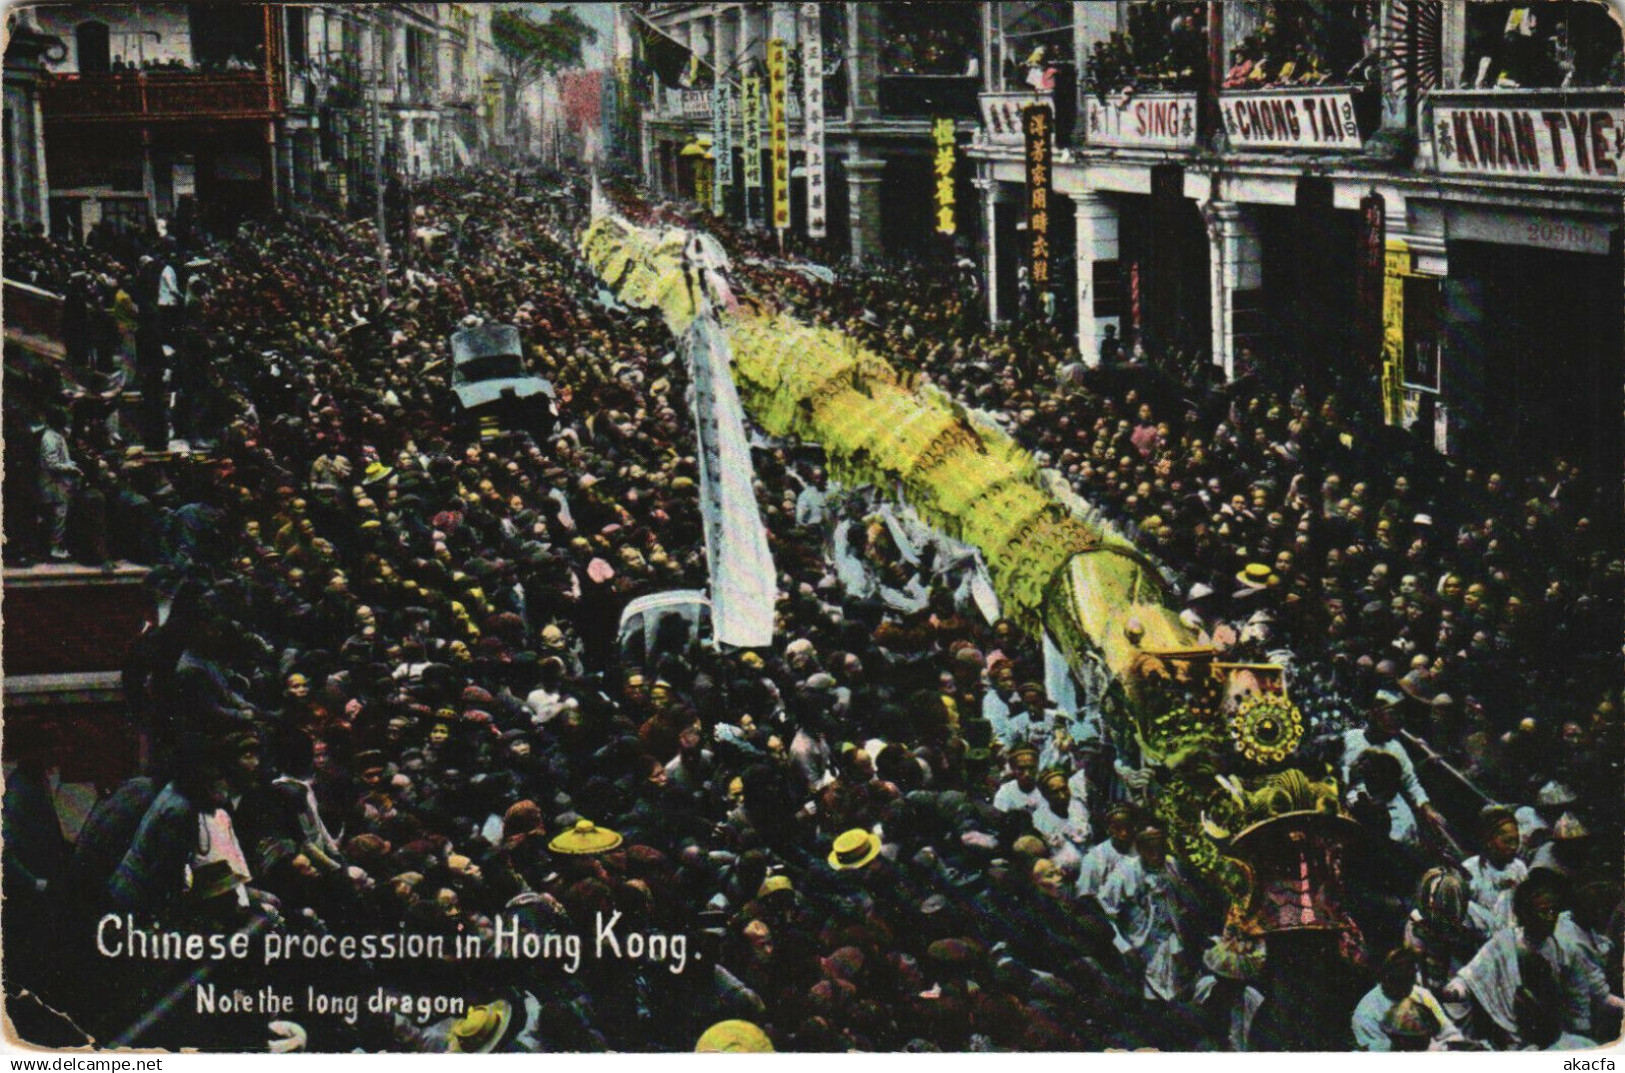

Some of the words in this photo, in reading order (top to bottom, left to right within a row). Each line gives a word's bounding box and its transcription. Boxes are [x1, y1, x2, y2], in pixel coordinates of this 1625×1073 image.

[1135, 101, 1178, 138] SING
[1234, 99, 1301, 141] CHONG
[1303, 97, 1345, 142] TAI
[1451, 110, 1541, 173] KWAN
[1541, 110, 1618, 176] TYE
